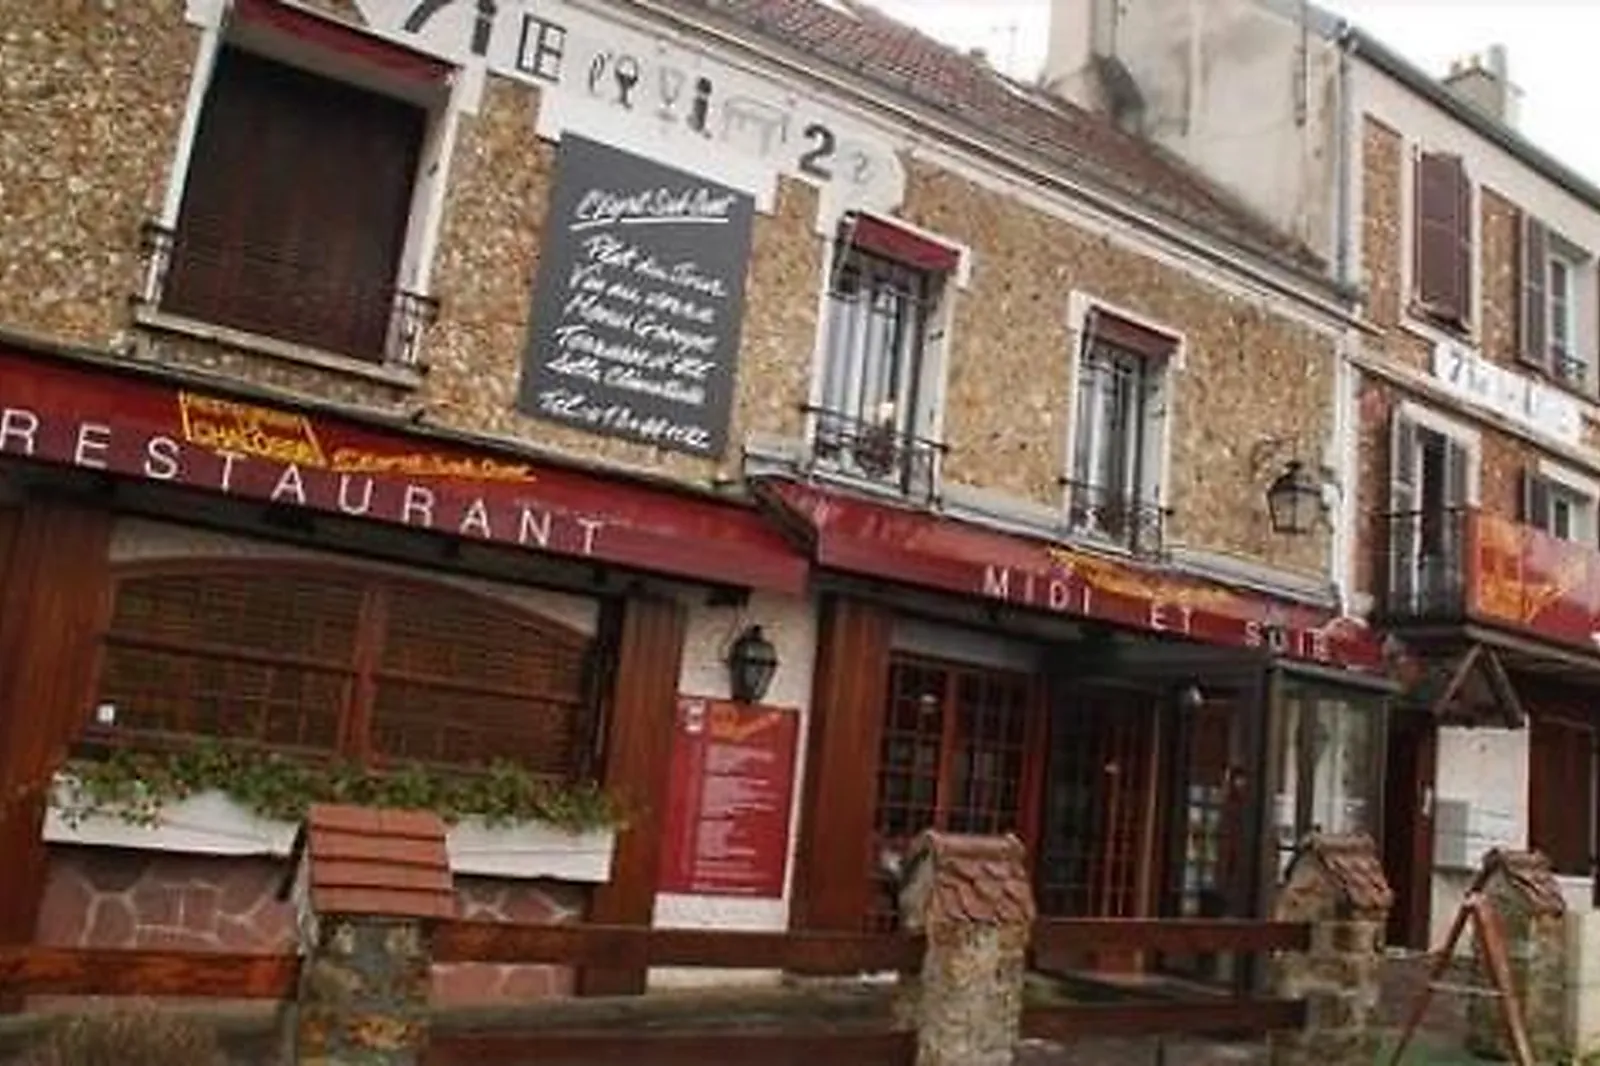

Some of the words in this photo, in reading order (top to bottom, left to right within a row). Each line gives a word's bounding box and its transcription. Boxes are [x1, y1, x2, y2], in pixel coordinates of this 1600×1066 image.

[0, 407, 606, 556] RESTAURANT
[983, 564, 1092, 616] MIDI
[1151, 602, 1193, 636] ET
